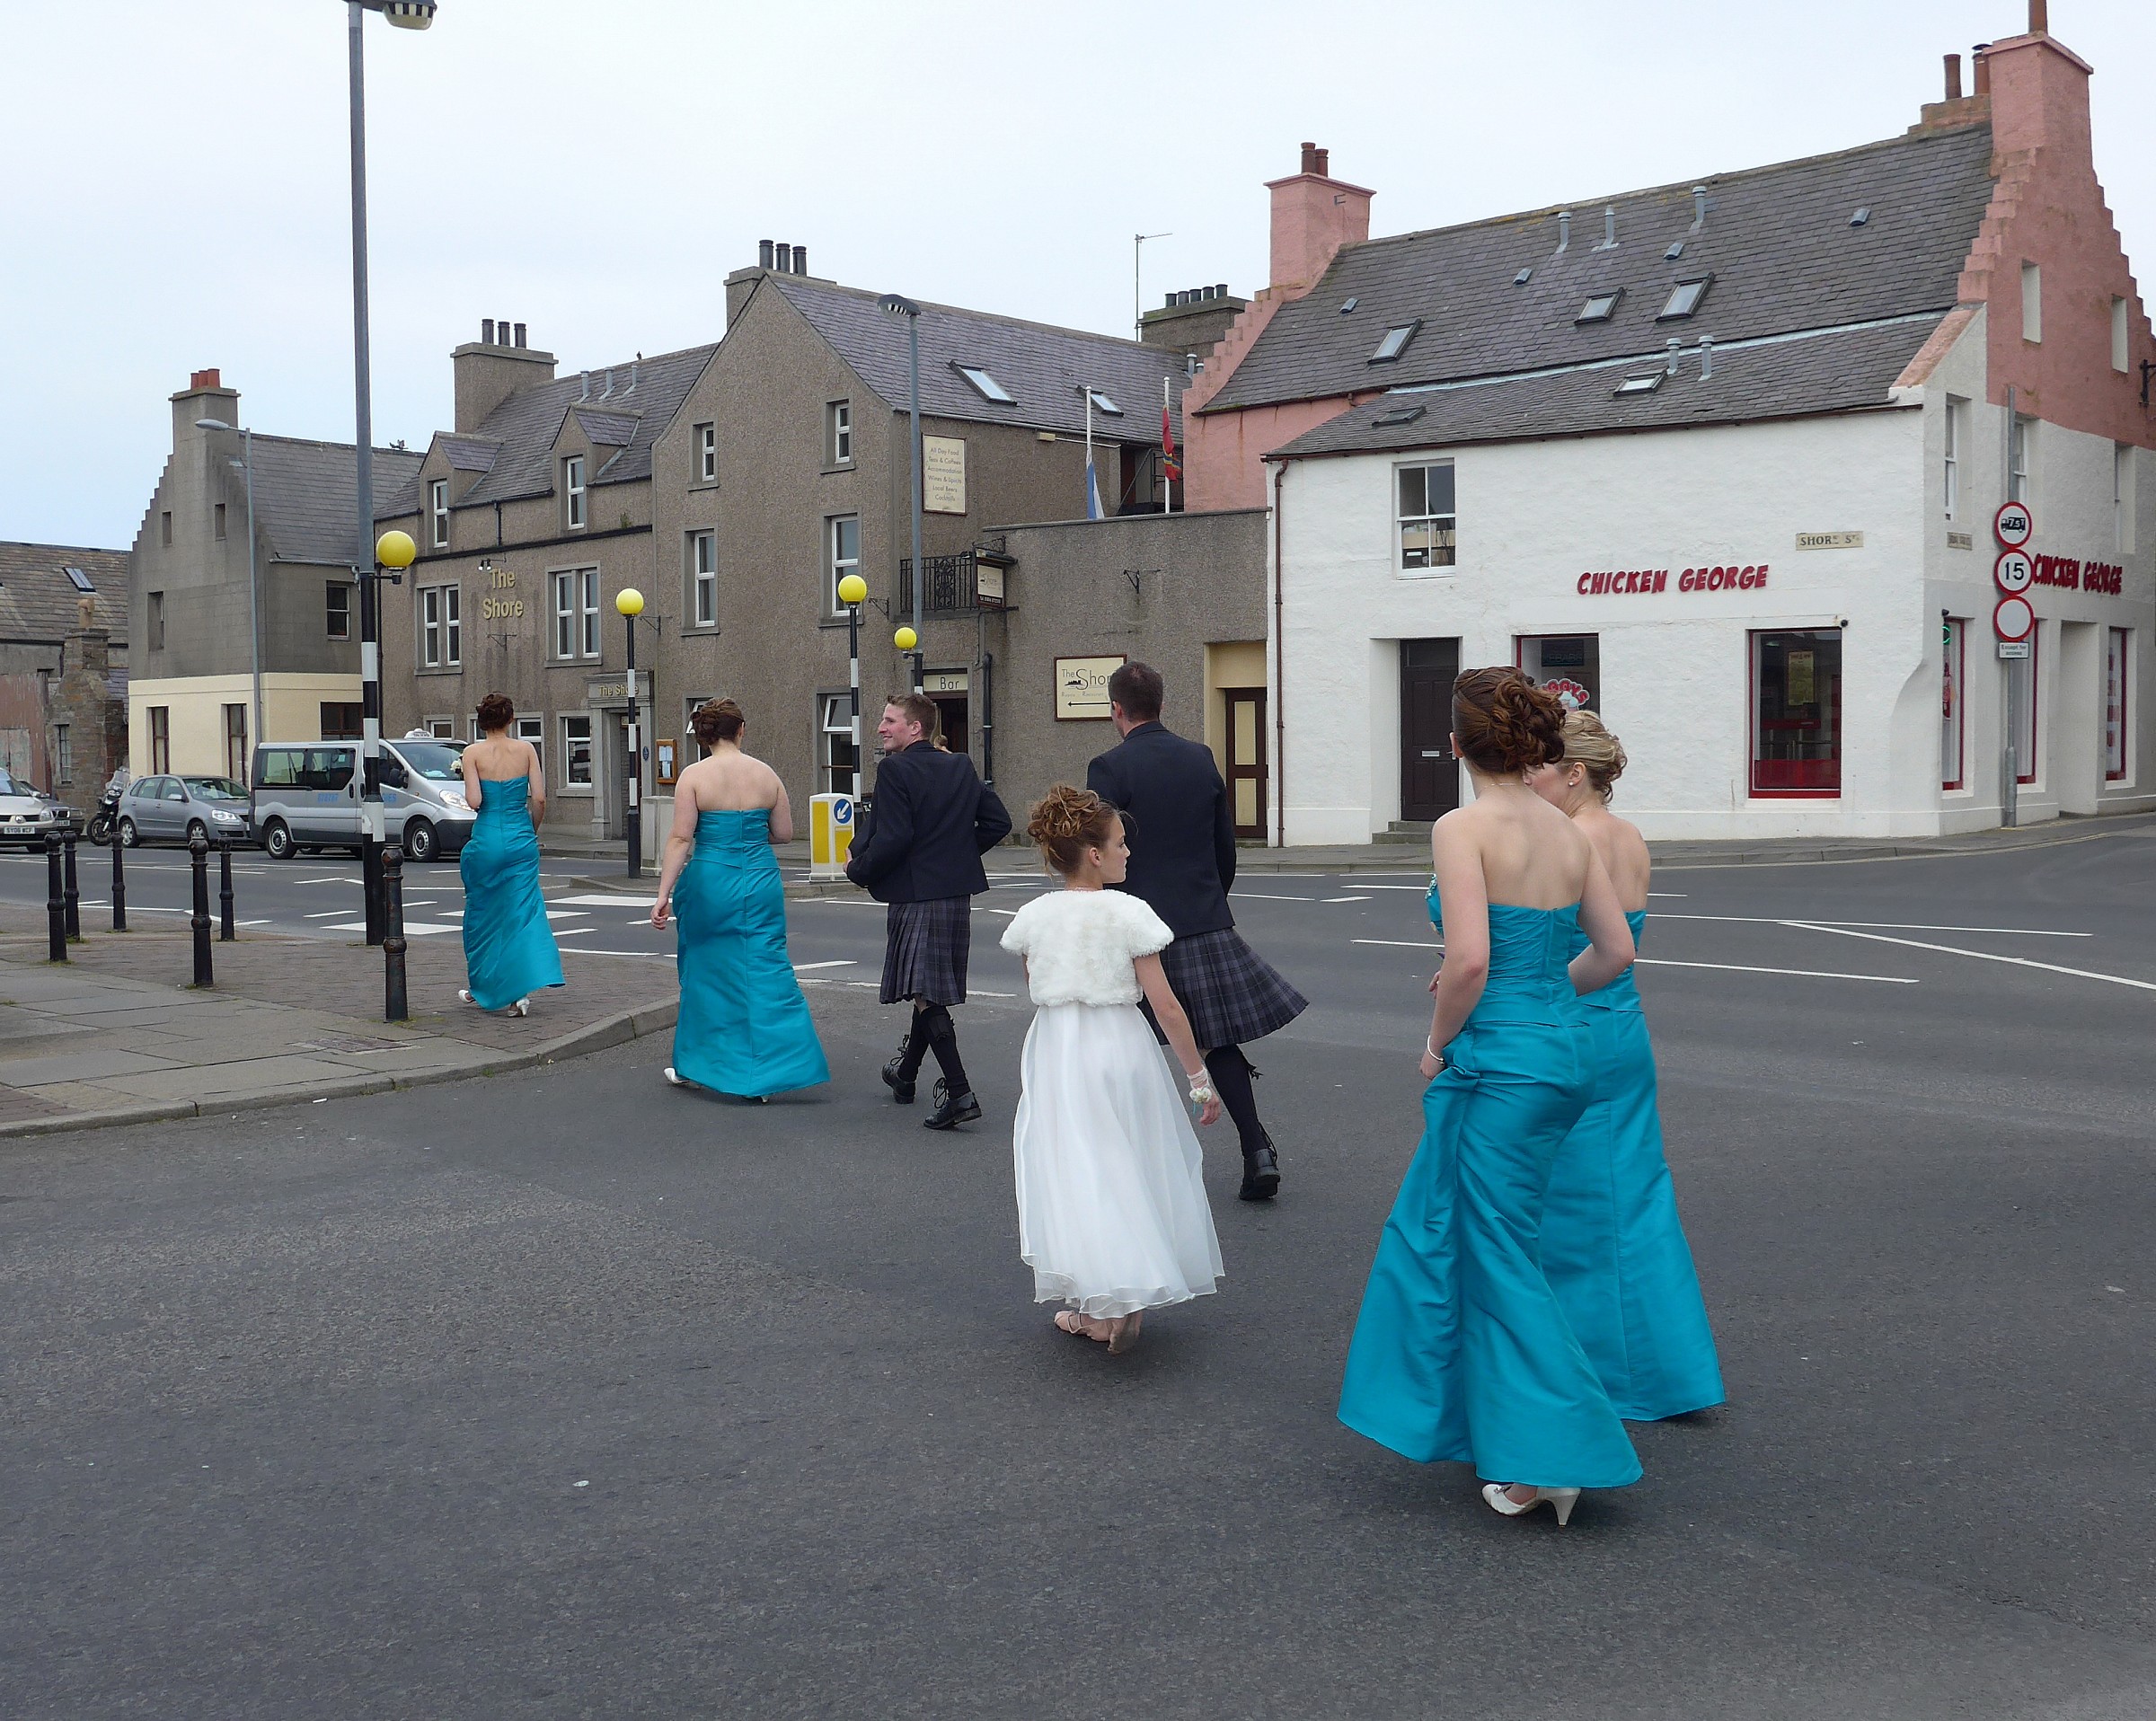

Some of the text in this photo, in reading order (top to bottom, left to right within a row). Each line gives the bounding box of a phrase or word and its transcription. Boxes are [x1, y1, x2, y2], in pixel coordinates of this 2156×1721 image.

[490, 568, 516, 589] The
[1577, 564, 1769, 596] CHICKEN GEORGE
[2005, 561, 2025, 581] 15
[2031, 553, 2123, 596] CHICKEN GEORGE
[482, 597, 524, 620] Shore
[940, 676, 959, 690] Bar
[1061, 668, 1075, 678] The
[598, 684, 639, 696] The She
